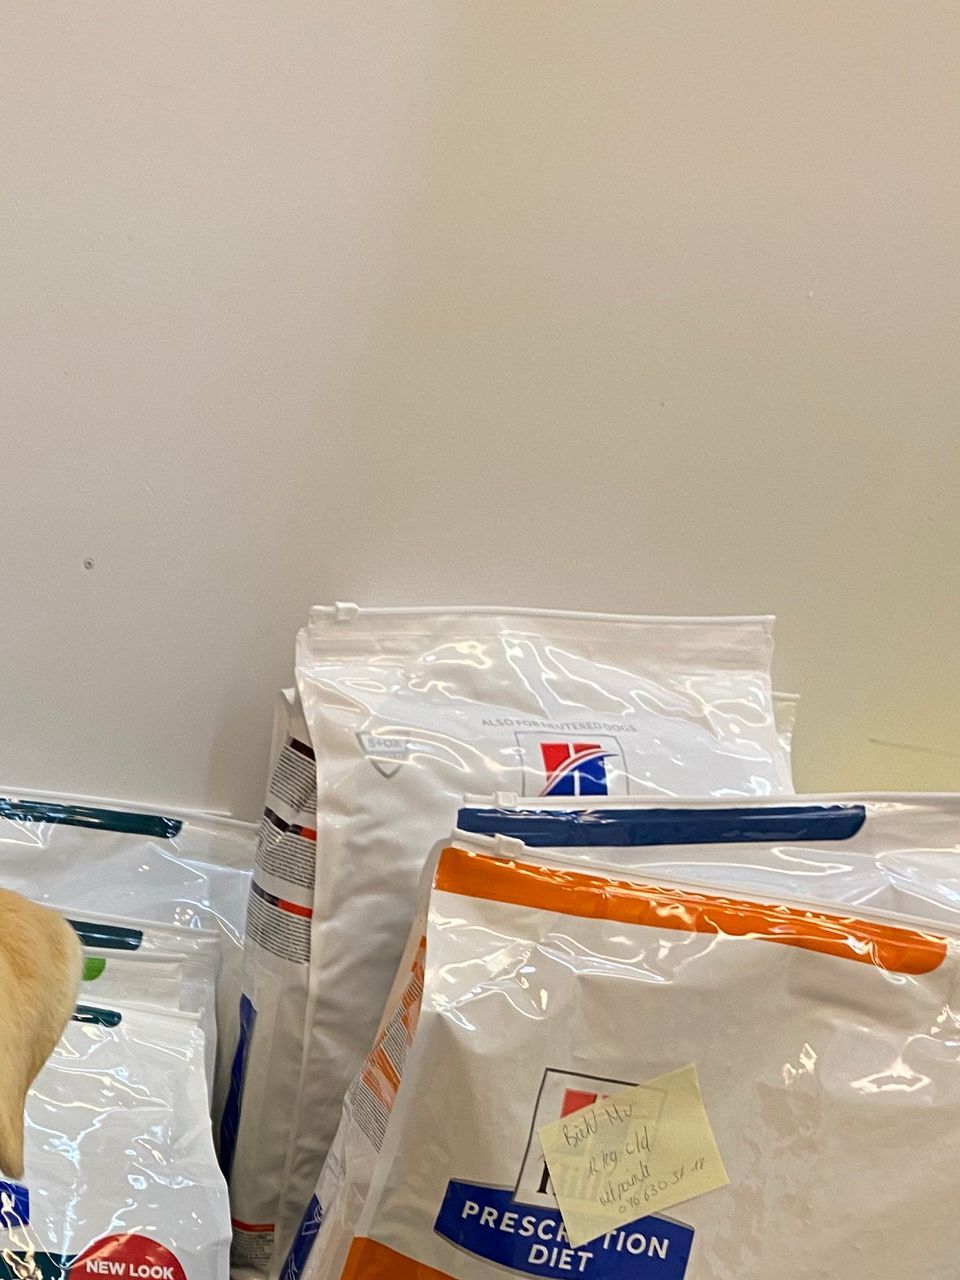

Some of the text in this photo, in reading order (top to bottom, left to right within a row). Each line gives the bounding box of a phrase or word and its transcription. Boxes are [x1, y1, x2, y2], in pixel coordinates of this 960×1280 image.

[482, 719, 514, 727] ALSO
[515, 720, 539, 728] FOR
[603, 723, 638, 733] DOGS
[461, 1200, 670, 1260] PRESCRTION
[86, 1260, 175, 1280] NEW LOOK
[527, 1243, 594, 1273] DIET
